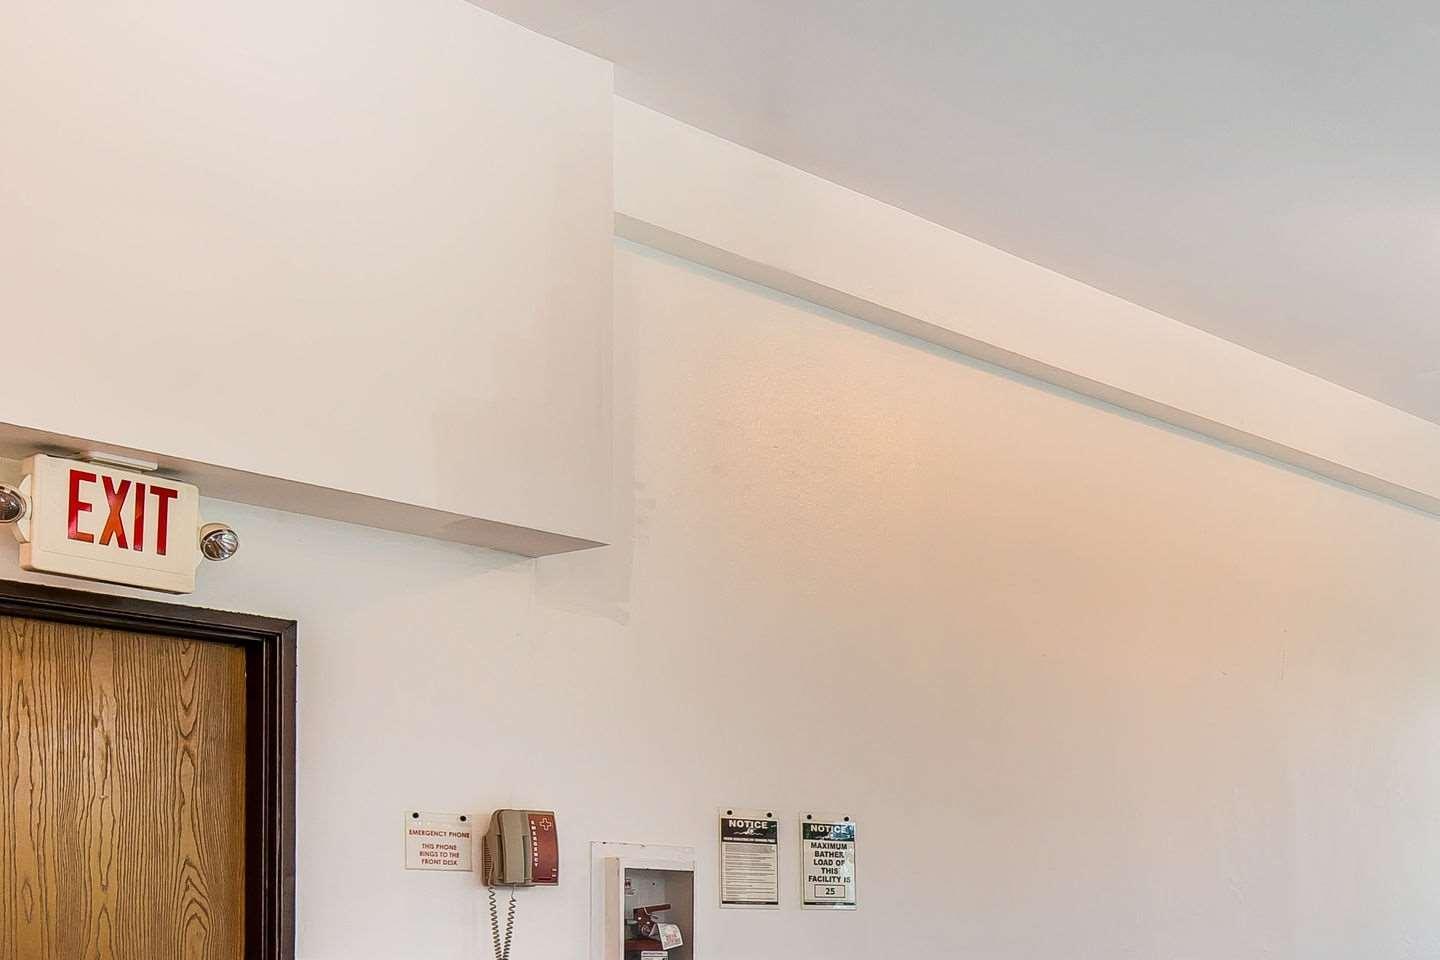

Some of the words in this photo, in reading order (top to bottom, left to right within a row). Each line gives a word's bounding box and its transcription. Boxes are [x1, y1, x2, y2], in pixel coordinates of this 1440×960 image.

[67, 469, 178, 556] EXIT
[728, 820, 769, 829] NOTICE
[810, 825, 848, 833] NOTICE
[408, 829, 447, 837] EMERGENCY
[448, 831, 470, 839] PHONE
[810, 842, 848, 850] MAXIMUM
[814, 850, 845, 858] BATHER
[813, 858, 834, 866] LOAD
[835, 859, 845, 867] OF
[821, 867, 839, 875] THIS
[808, 875, 842, 883] FACILITY
[825, 887, 836, 896] 25
